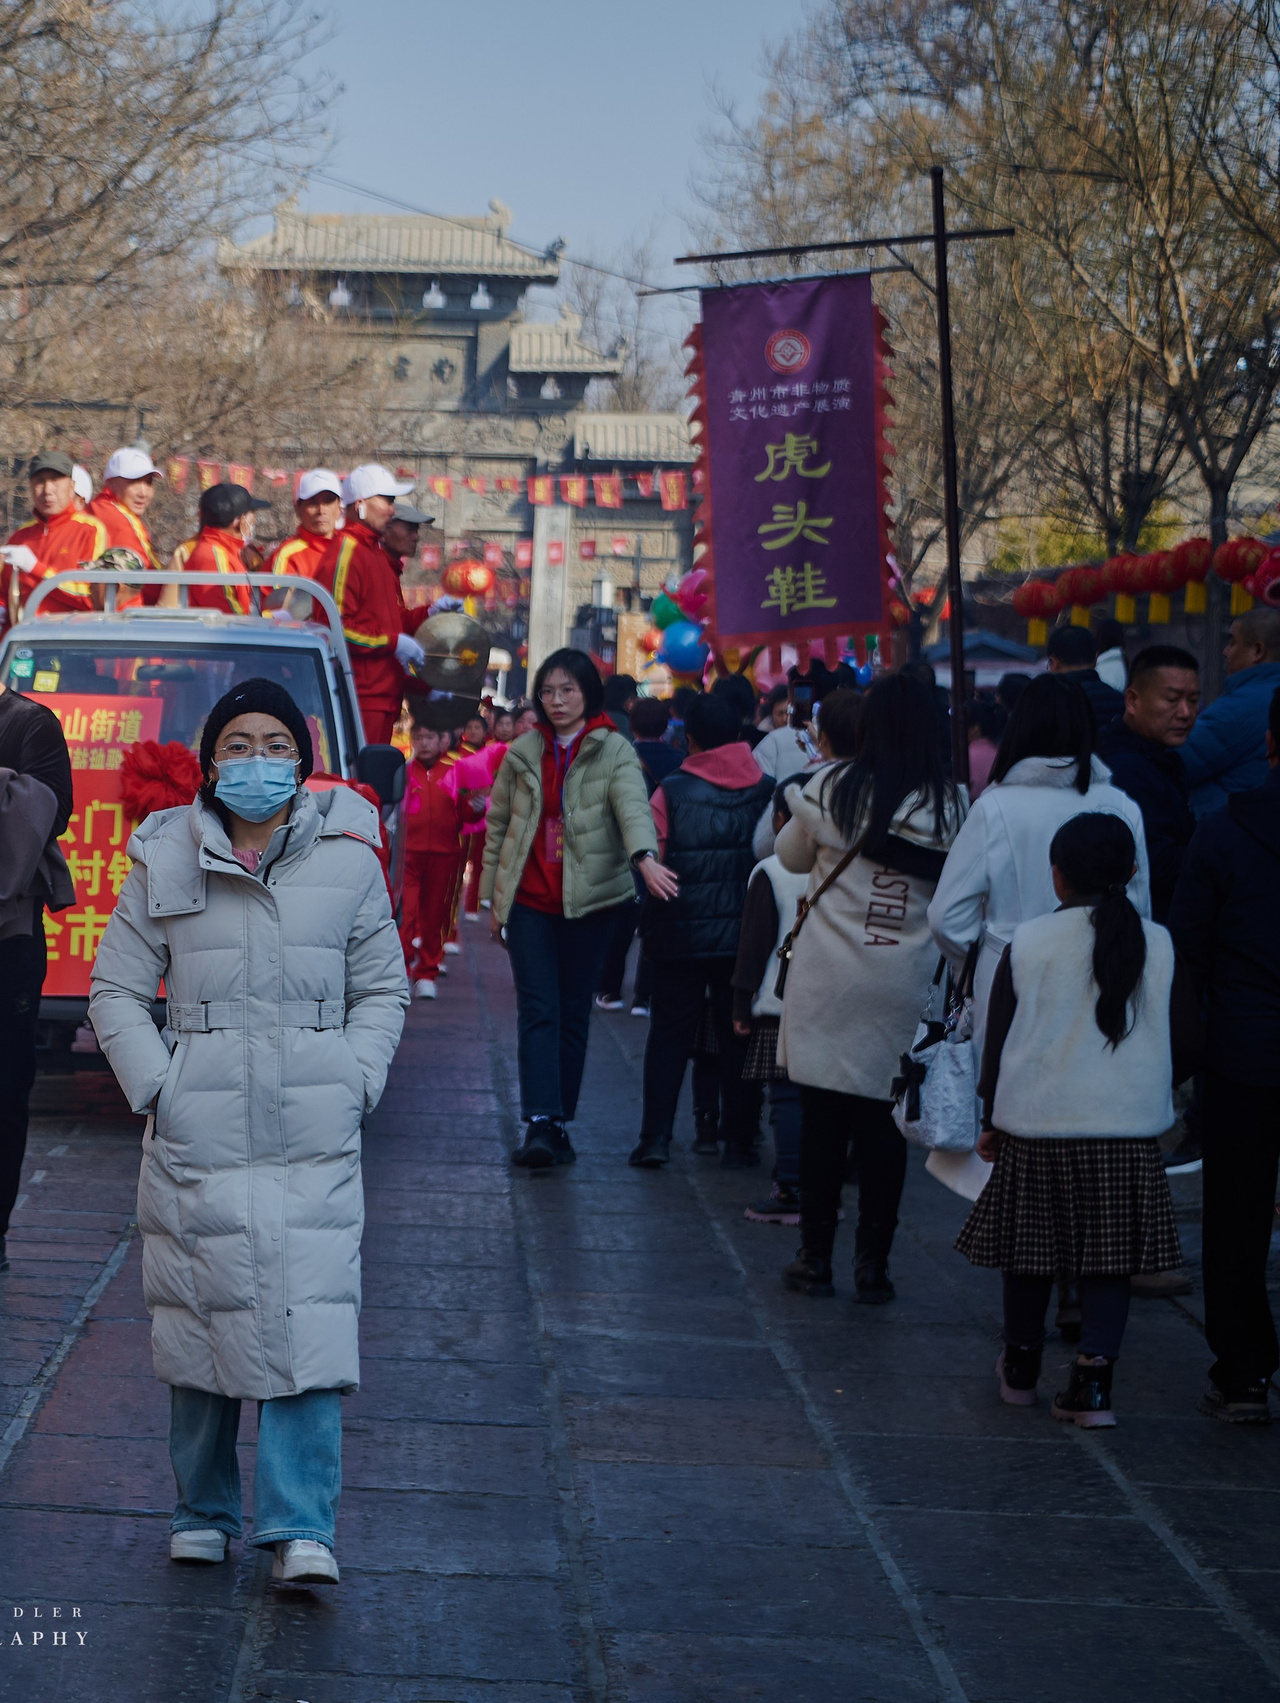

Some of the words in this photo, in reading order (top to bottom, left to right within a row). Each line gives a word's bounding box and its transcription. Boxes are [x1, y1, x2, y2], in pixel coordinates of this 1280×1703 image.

[754, 432, 837, 616] 虎头鞋
[52, 707, 143, 744] 山街道
